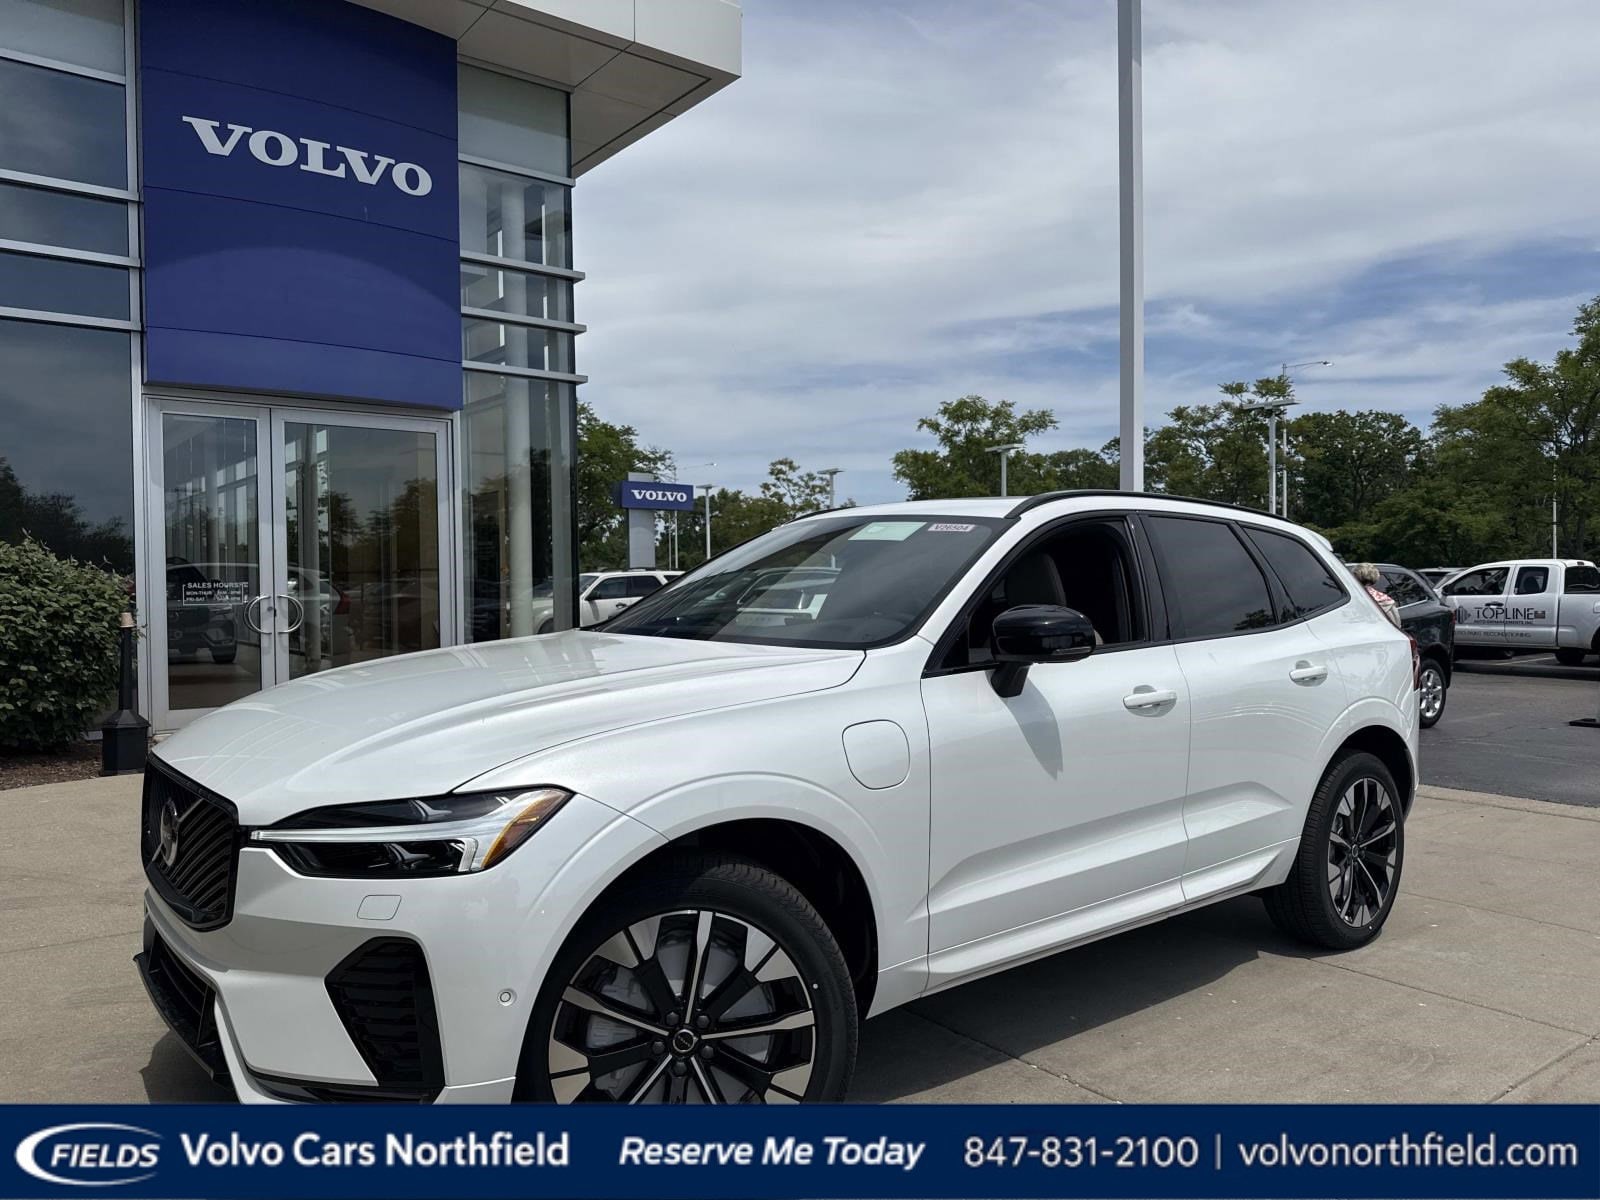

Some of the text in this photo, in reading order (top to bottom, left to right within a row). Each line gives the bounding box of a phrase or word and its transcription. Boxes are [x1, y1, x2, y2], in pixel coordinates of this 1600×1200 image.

[182, 115, 433, 197] VOLVO
[631, 489, 688, 503] VOLVO
[1474, 607, 1535, 620] TOPLINE
